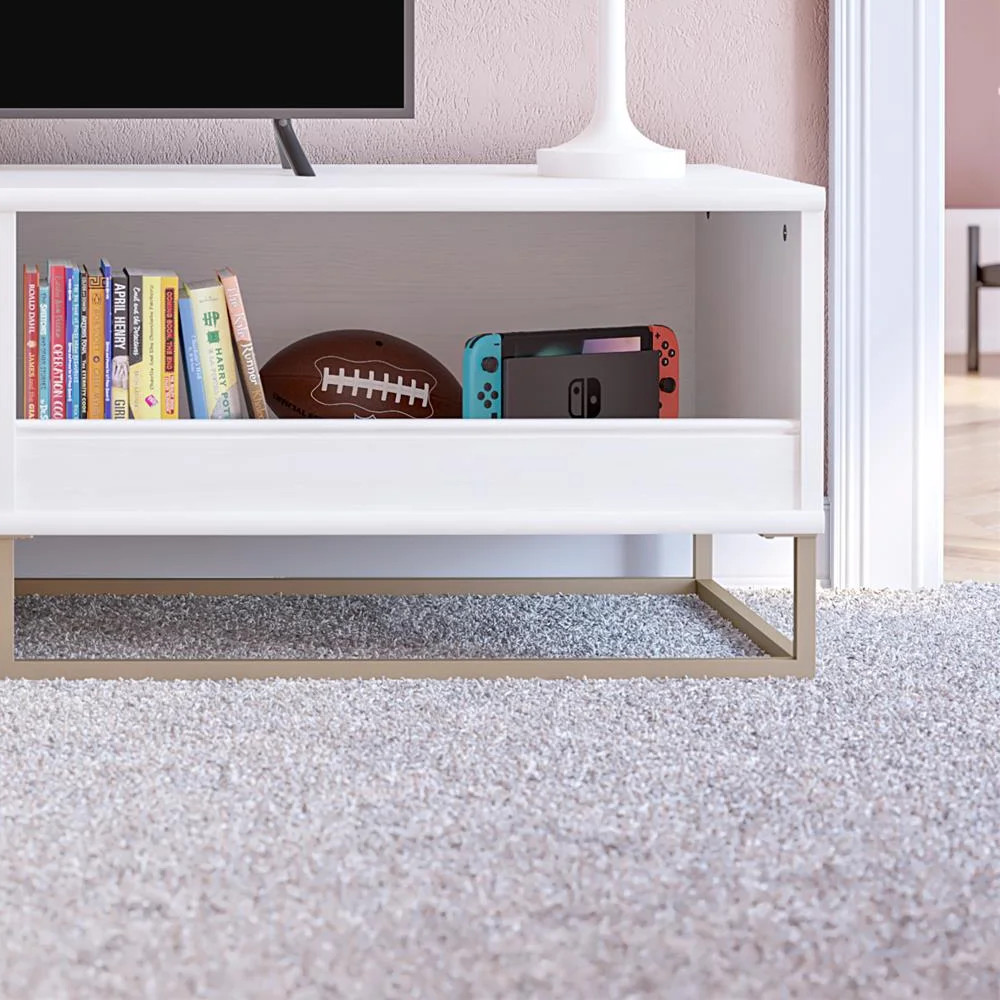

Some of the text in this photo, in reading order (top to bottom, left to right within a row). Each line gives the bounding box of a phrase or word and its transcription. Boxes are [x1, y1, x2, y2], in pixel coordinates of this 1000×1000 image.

[28, 284, 36, 334] ROALD DAHL
[113, 283, 126, 350] APRIL HENRY
[28, 352, 36, 377] JAMES
[52, 344, 64, 398] OPERATION
[215, 347, 227, 386] HARRY
[240, 342, 258, 385] Runner
